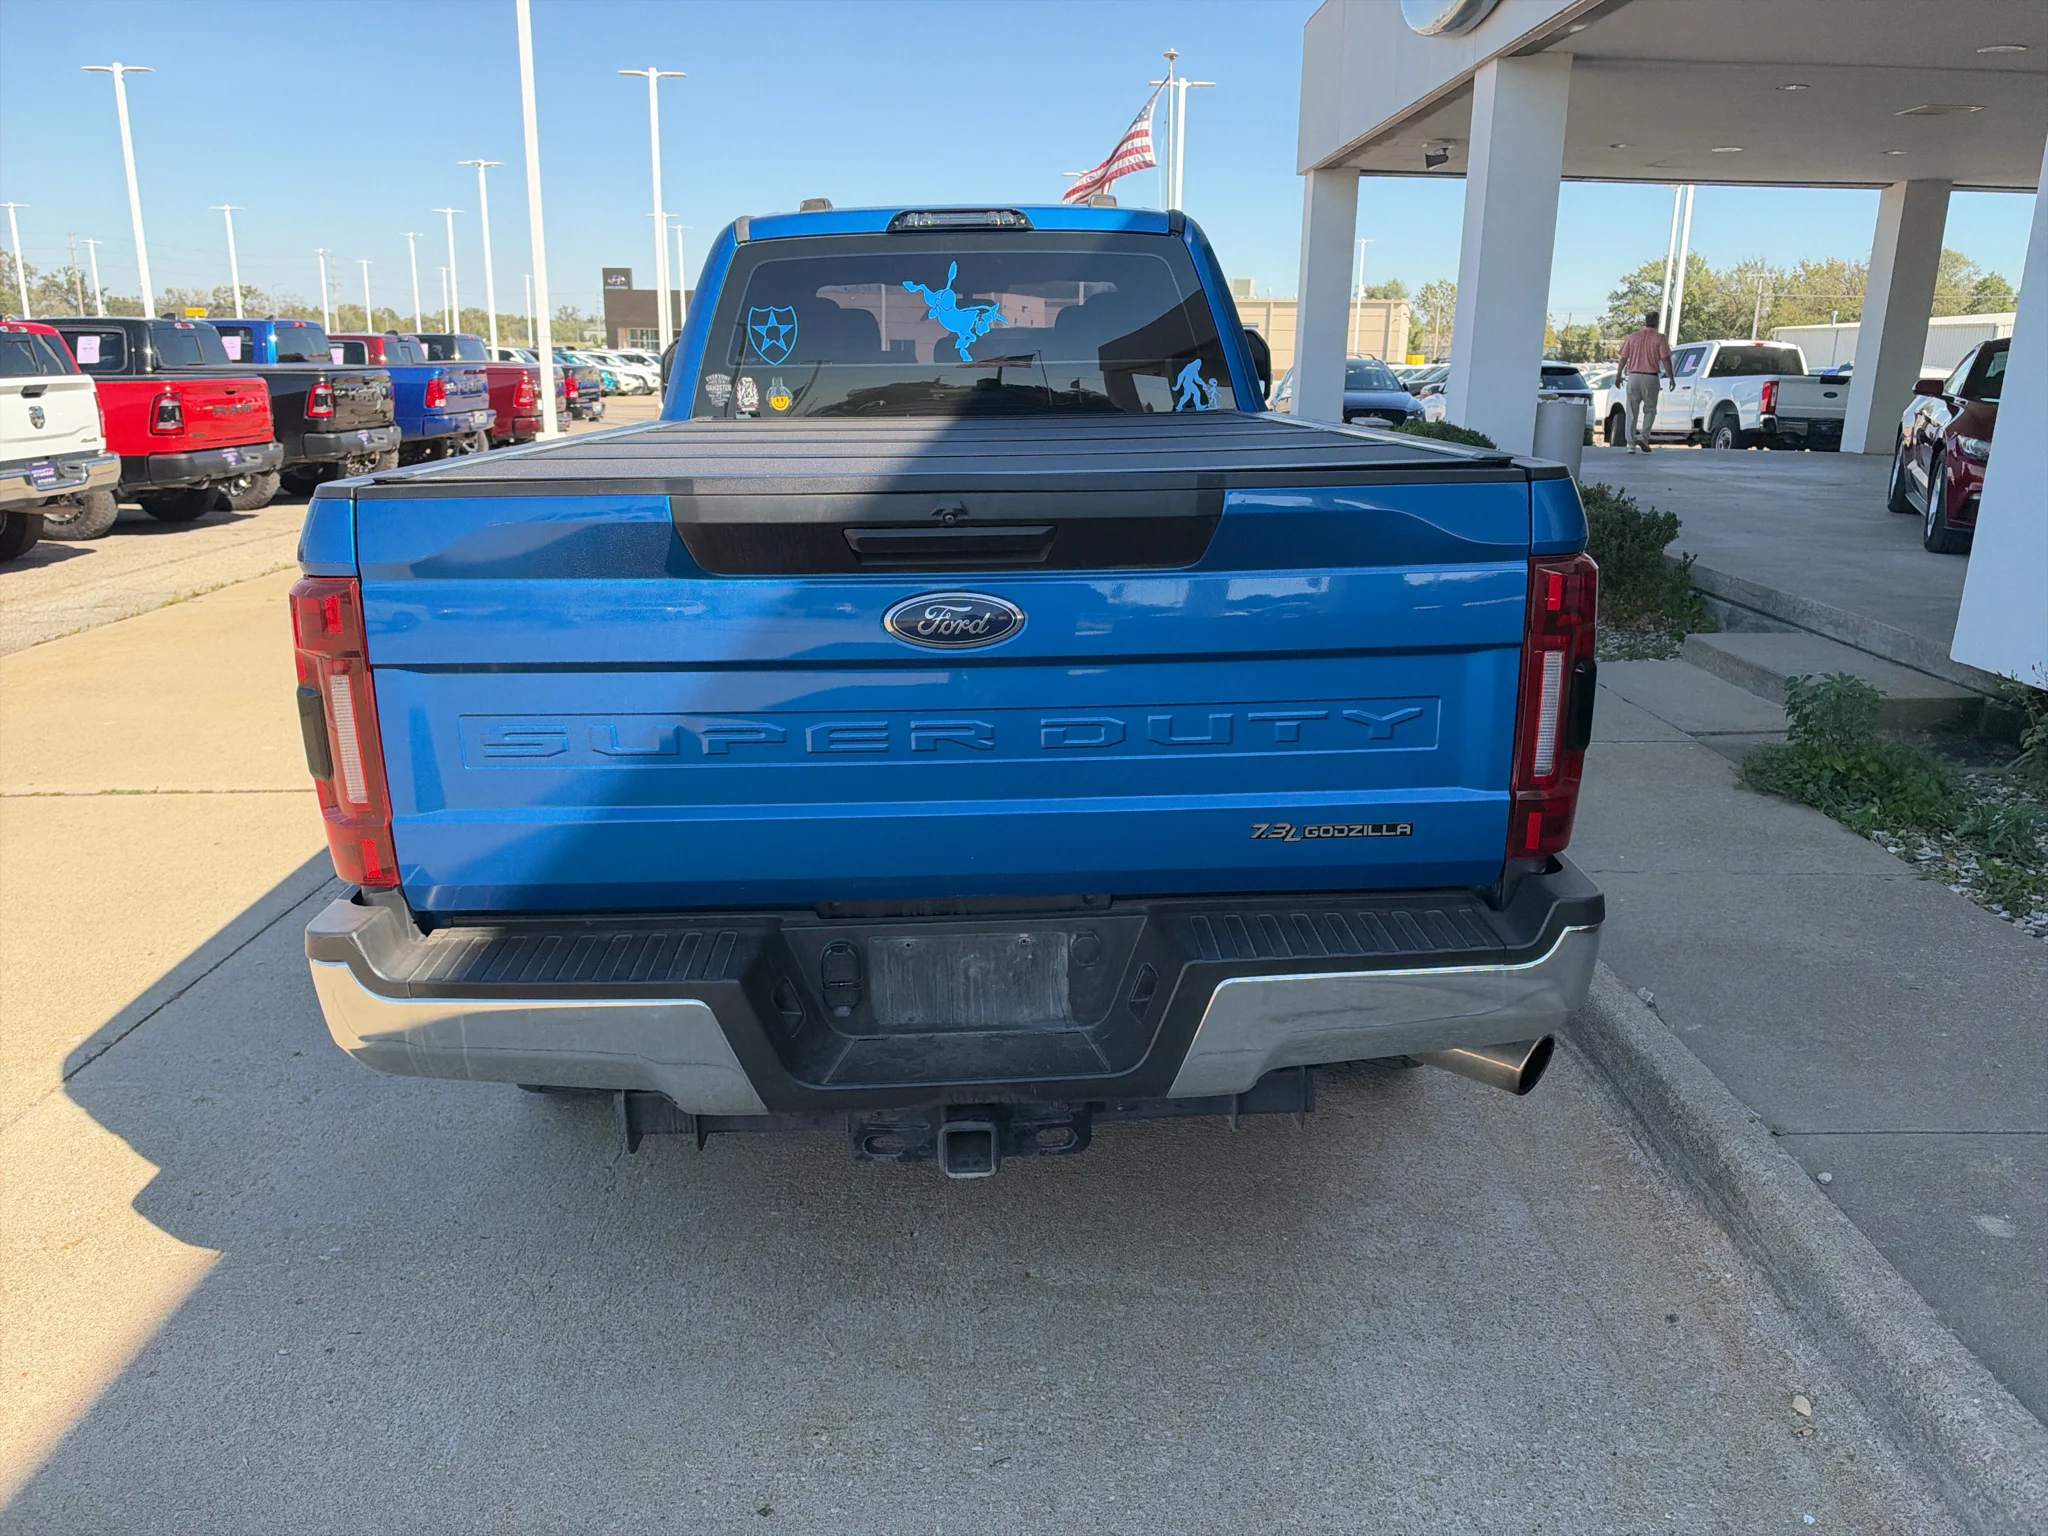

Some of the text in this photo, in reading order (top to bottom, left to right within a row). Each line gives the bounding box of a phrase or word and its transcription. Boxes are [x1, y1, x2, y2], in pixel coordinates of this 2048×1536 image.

[212, 404, 253, 416] RAM
[917, 604, 992, 636] Ford
[482, 706, 1424, 758] SUPER DUTY
[1250, 822, 1412, 843] 7.3L GODZILLA
